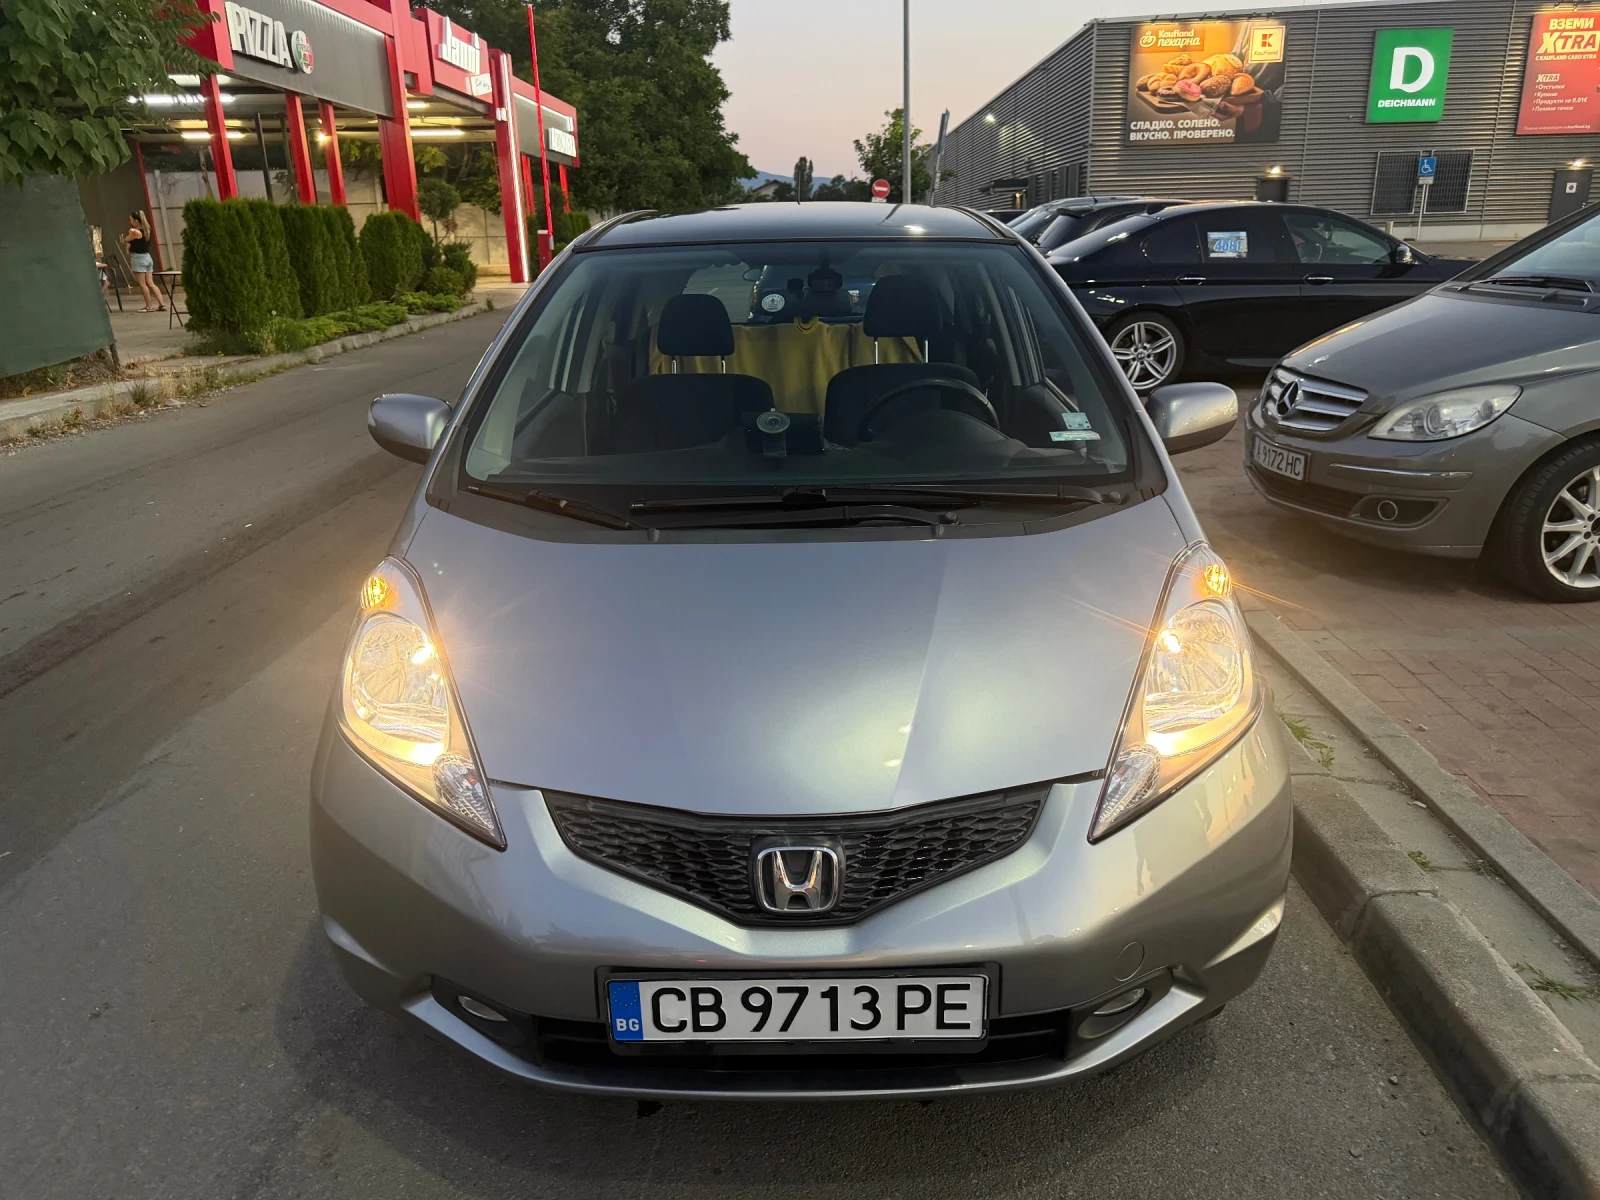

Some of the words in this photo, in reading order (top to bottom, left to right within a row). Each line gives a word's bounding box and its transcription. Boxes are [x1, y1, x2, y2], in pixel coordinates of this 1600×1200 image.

[1549, 17, 1595, 31] ВЗЕМИ
[225, 1, 293, 69] PIZZA
[1158, 29, 1194, 38] Kaufland
[1157, 38, 1201, 48] пекарна
[1536, 31, 1599, 54] XTRA
[1389, 46, 1435, 93] D
[1536, 73, 1560, 83] XTRA
[1378, 98, 1436, 108] DEICHMANN
[1130, 120, 1176, 130] СЛАДКО.
[1177, 118, 1221, 128] СОЛЕНО.
[1129, 131, 1171, 141] ВКУСНО.
[1173, 129, 1235, 139] ПРОВЕРЕНО.
[1263, 445, 1284, 471] 9172
[1285, 450, 1302, 476] HC
[651, 986, 727, 1033] CB
[740, 985, 882, 1032] 9713
[896, 983, 971, 1031] PE
[616, 1018, 640, 1032] BG
